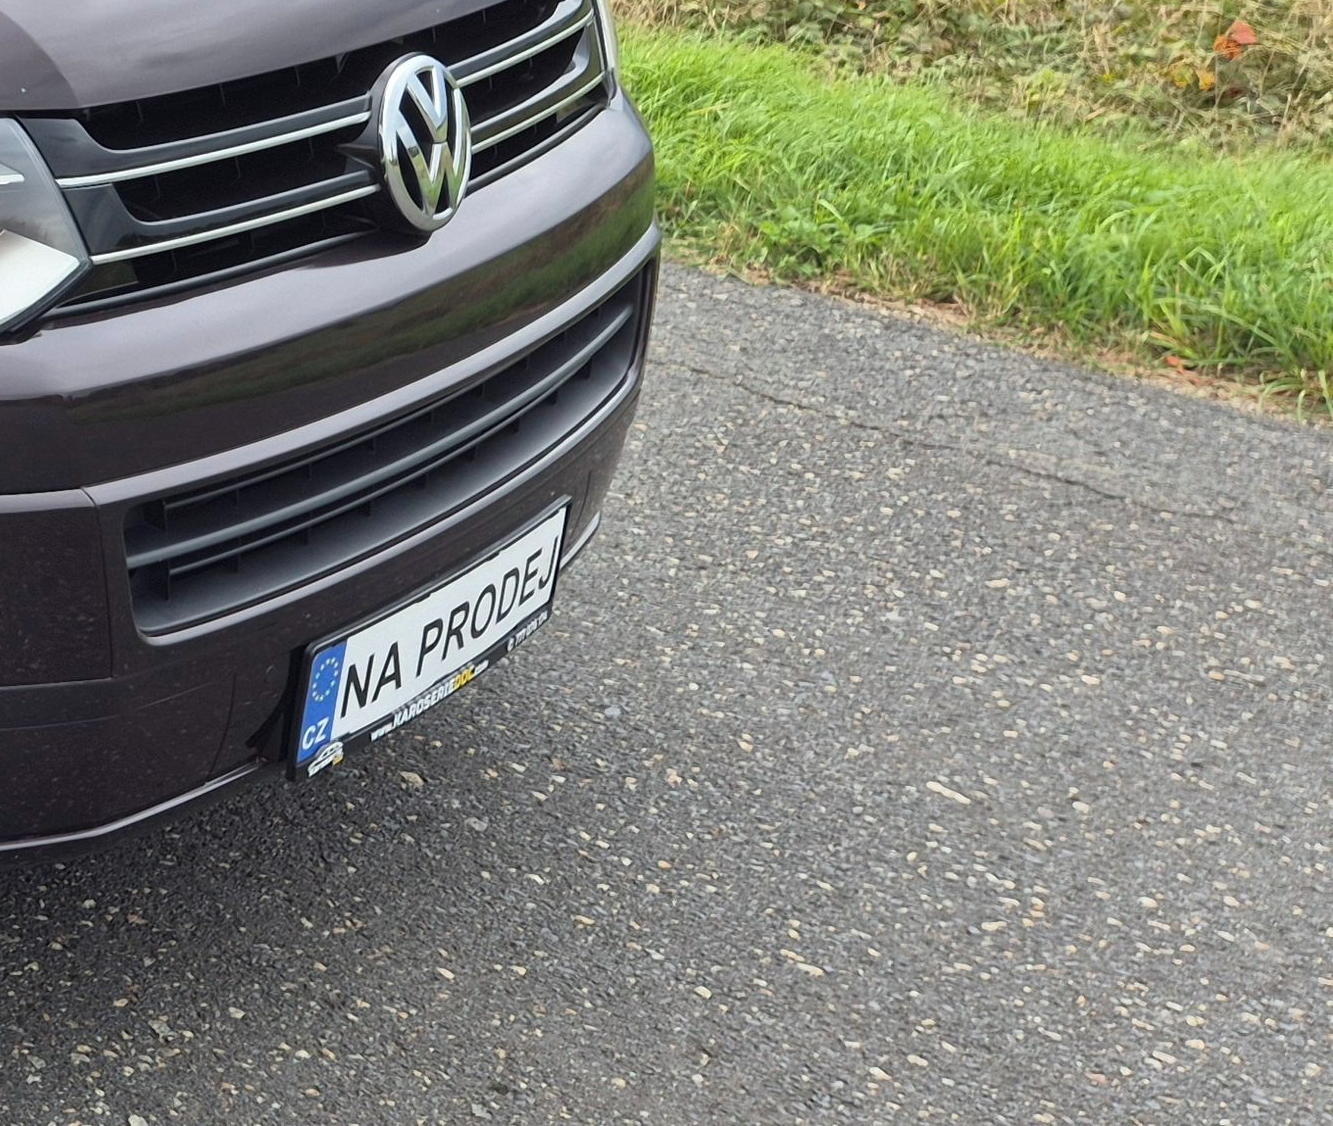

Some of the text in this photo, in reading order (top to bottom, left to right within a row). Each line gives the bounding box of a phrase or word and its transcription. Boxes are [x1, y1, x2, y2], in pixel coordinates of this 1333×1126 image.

[340, 535, 559, 719] NA PRODEJ
[301, 717, 330, 750] CZ
